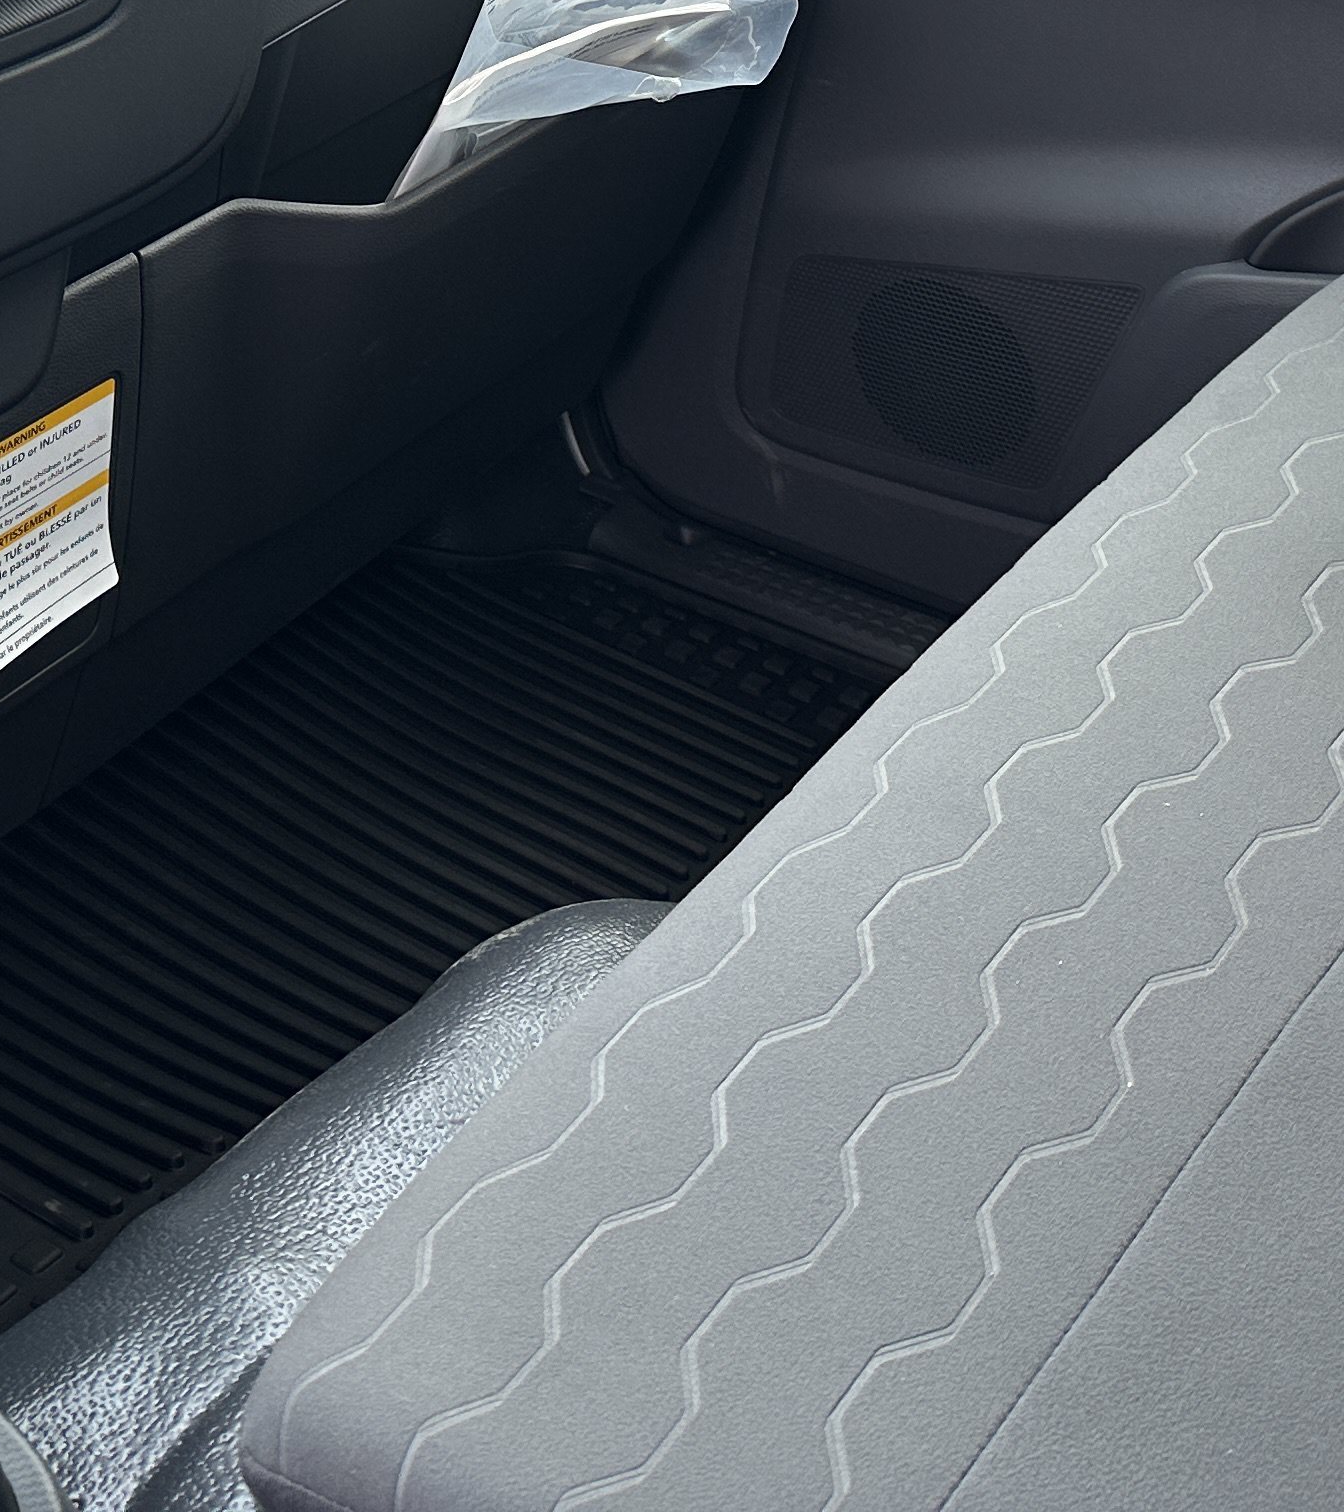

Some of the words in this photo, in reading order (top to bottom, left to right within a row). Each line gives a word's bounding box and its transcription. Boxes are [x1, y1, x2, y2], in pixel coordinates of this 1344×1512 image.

[27, 446, 37, 457] or
[39, 419, 81, 449] INJURED
[1, 484, 20, 501] place
[72, 444, 85, 457] and
[4, 494, 18, 508] seat
[3, 542, 22, 562] TUÉ
[24, 537, 36, 549] ou
[38, 511, 71, 541] BLESSÉ
[73, 503, 88, 520] par
[90, 495, 101, 507] un
[9, 542, 50, 575] passager.
[15, 572, 30, 587] plus
[42, 552, 58, 569] pour
